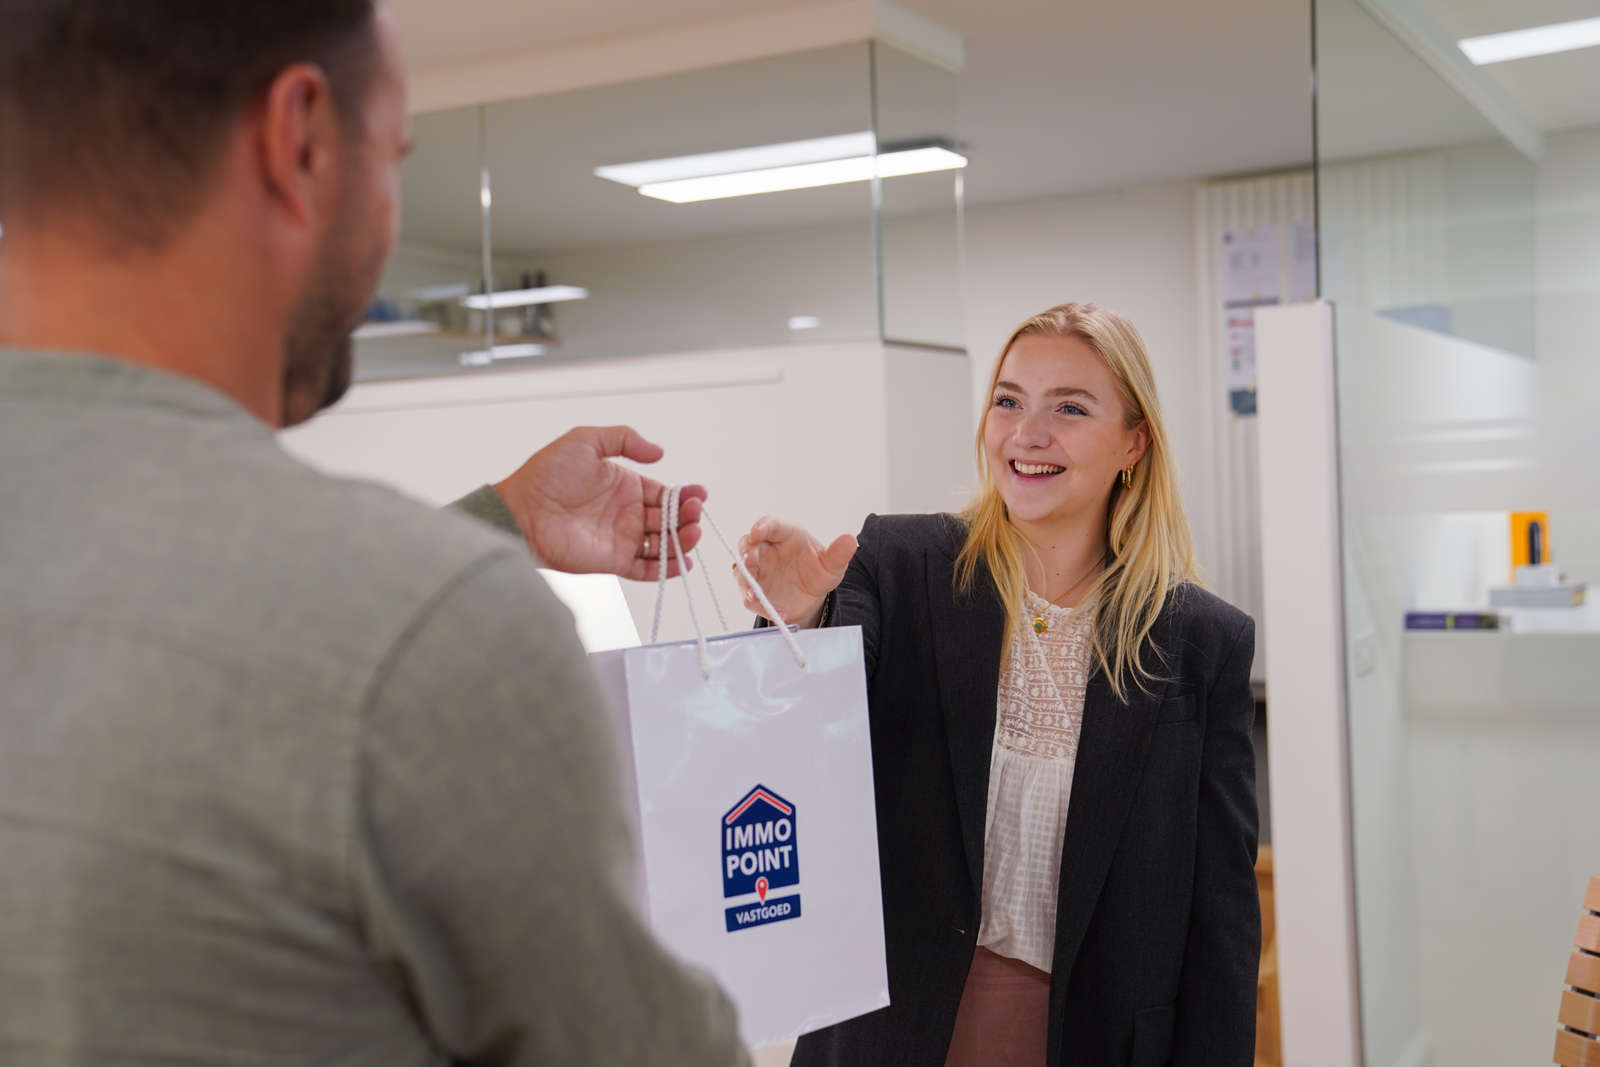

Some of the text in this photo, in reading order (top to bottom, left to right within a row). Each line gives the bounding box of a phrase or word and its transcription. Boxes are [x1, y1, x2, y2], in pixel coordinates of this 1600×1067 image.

[726, 818, 792, 851] IMMO
[726, 845, 792, 879] POINT
[735, 902, 791, 925] VASTGOED
